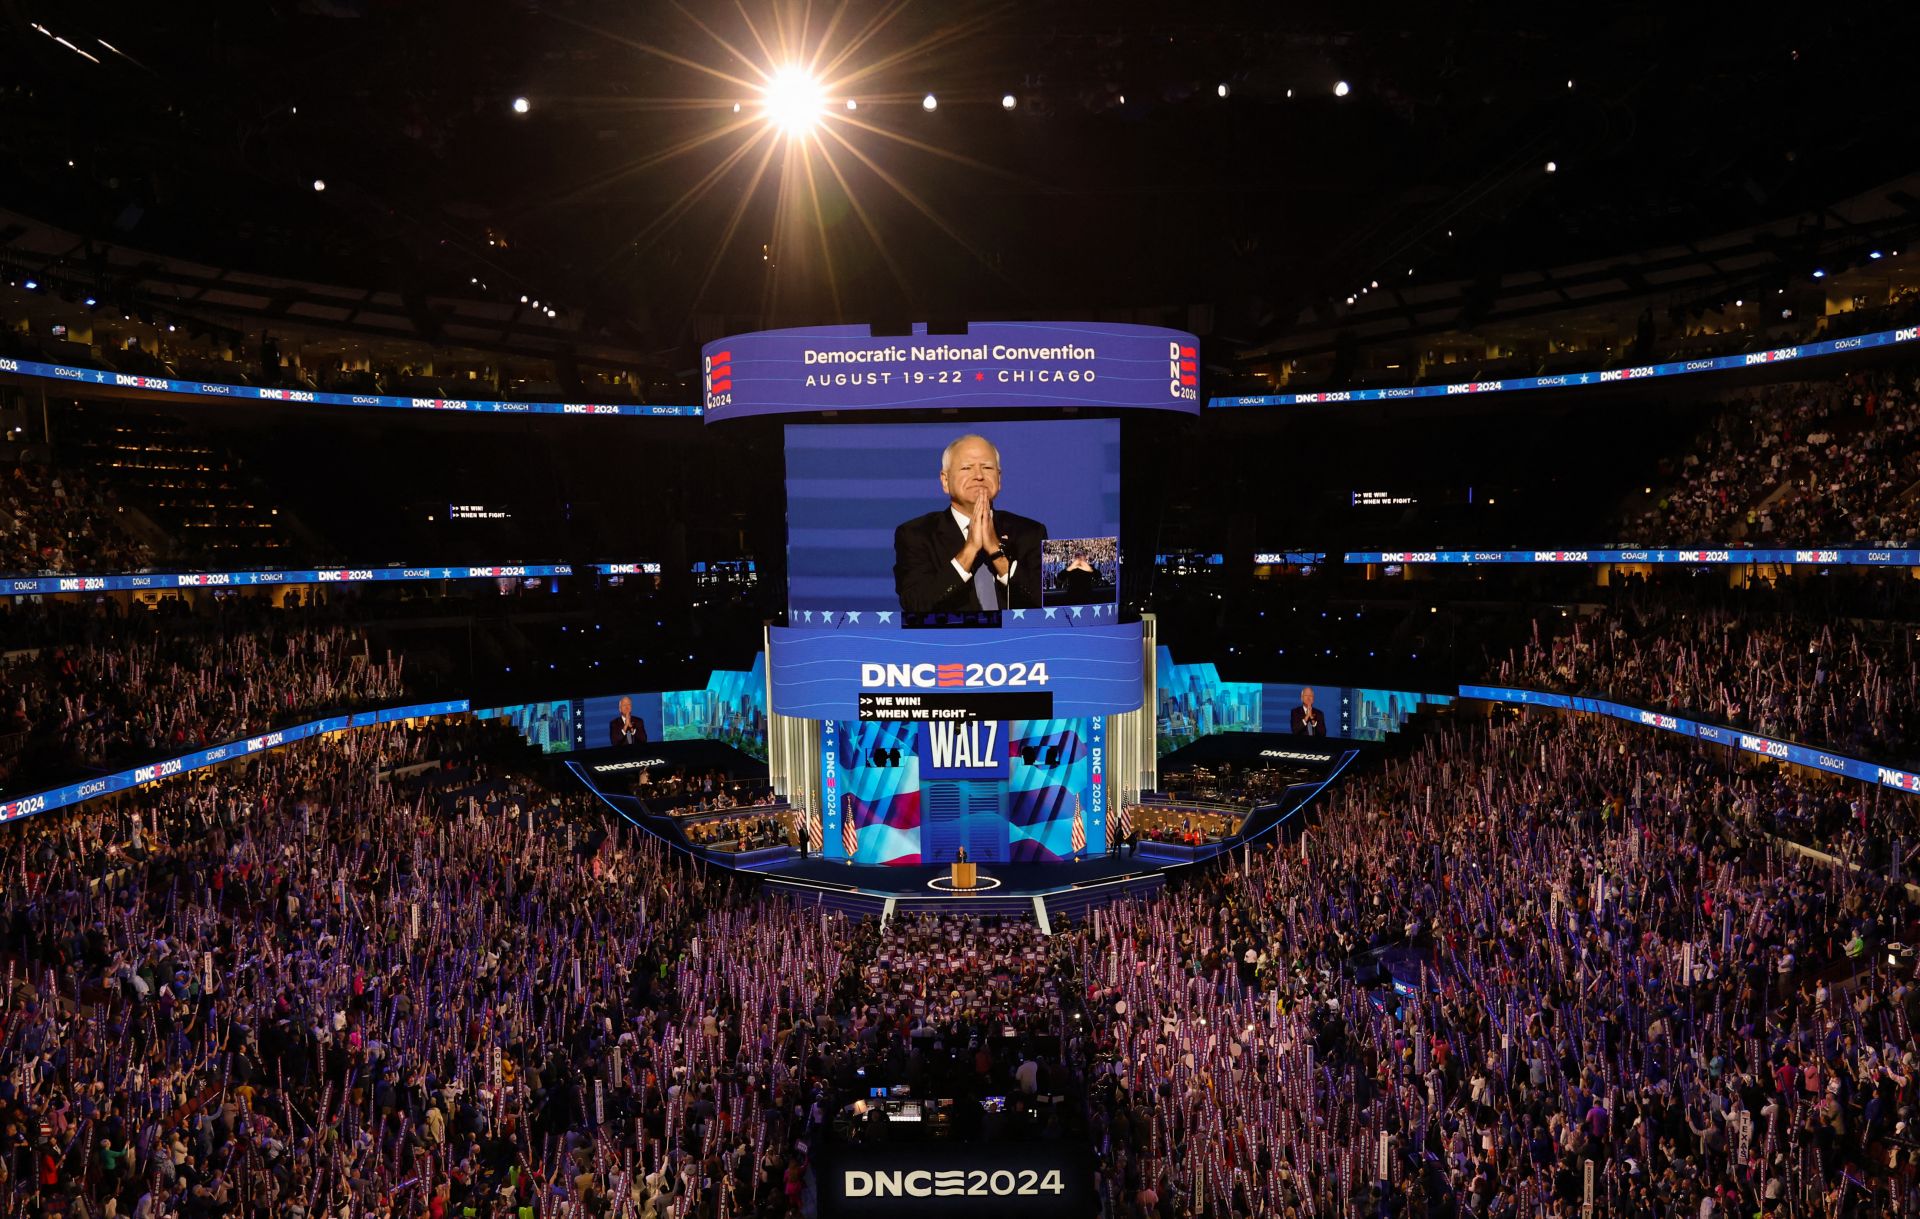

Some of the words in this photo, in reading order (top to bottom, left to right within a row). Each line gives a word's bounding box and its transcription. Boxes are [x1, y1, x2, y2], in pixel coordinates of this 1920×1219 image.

[1835, 338, 1861, 349] COACH
[805, 347, 906, 364] Democratic
[911, 345, 987, 360] National
[993, 344, 1094, 359] Convention
[1687, 361, 1713, 370] COACH
[55, 368, 82, 378] COACH
[806, 373, 891, 386] AUGUST
[904, 371, 961, 383] 19-22
[998, 370, 1095, 382] CHICAGO
[1538, 376, 1563, 386] COACH
[203, 385, 229, 393] COACH
[876, 697, 892, 705] WE
[895, 697, 920, 705] WIN!
[876, 710, 908, 718] WHEN
[912, 710, 929, 718] WE
[932, 710, 966, 718] FIGHT
[929, 721, 998, 767] WALZ
[1820, 755, 1844, 771] COACH
[80, 780, 106, 796] COACH
